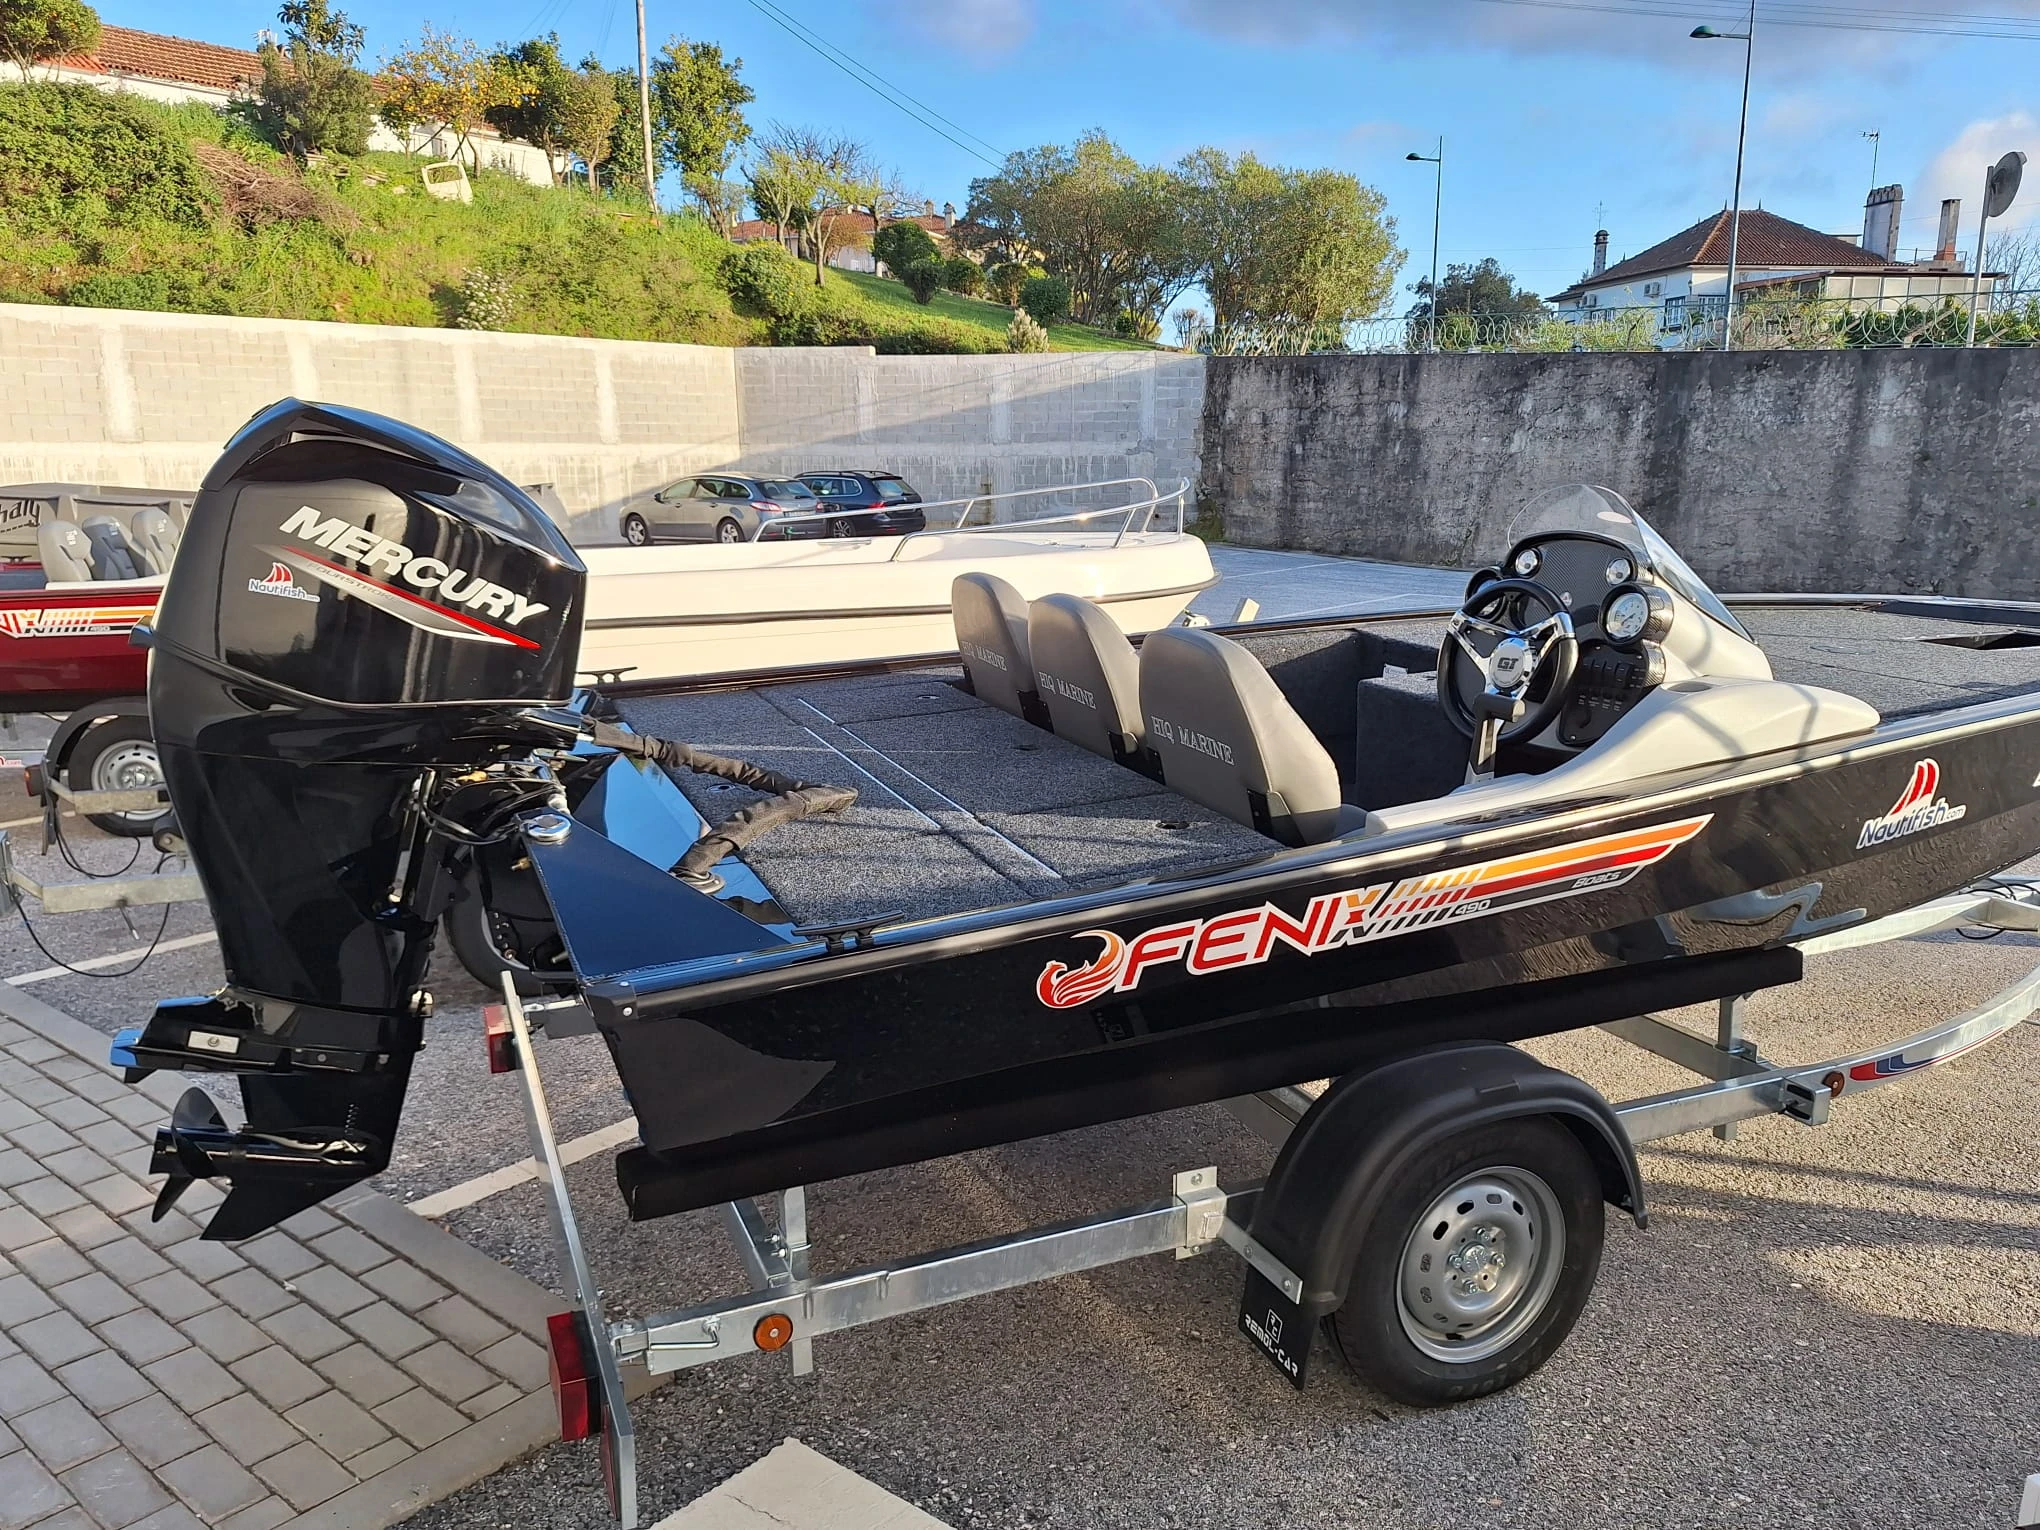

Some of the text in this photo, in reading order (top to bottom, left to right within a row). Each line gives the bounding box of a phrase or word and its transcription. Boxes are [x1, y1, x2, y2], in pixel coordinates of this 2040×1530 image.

[279, 505, 550, 626] MERCURY
[1497, 656, 1519, 671] GT
[1057, 678, 1097, 709] MARINE
[1151, 715, 1235, 765] HIQ MARINE
[1116, 870, 1622, 991] FENIX 490 Boats
